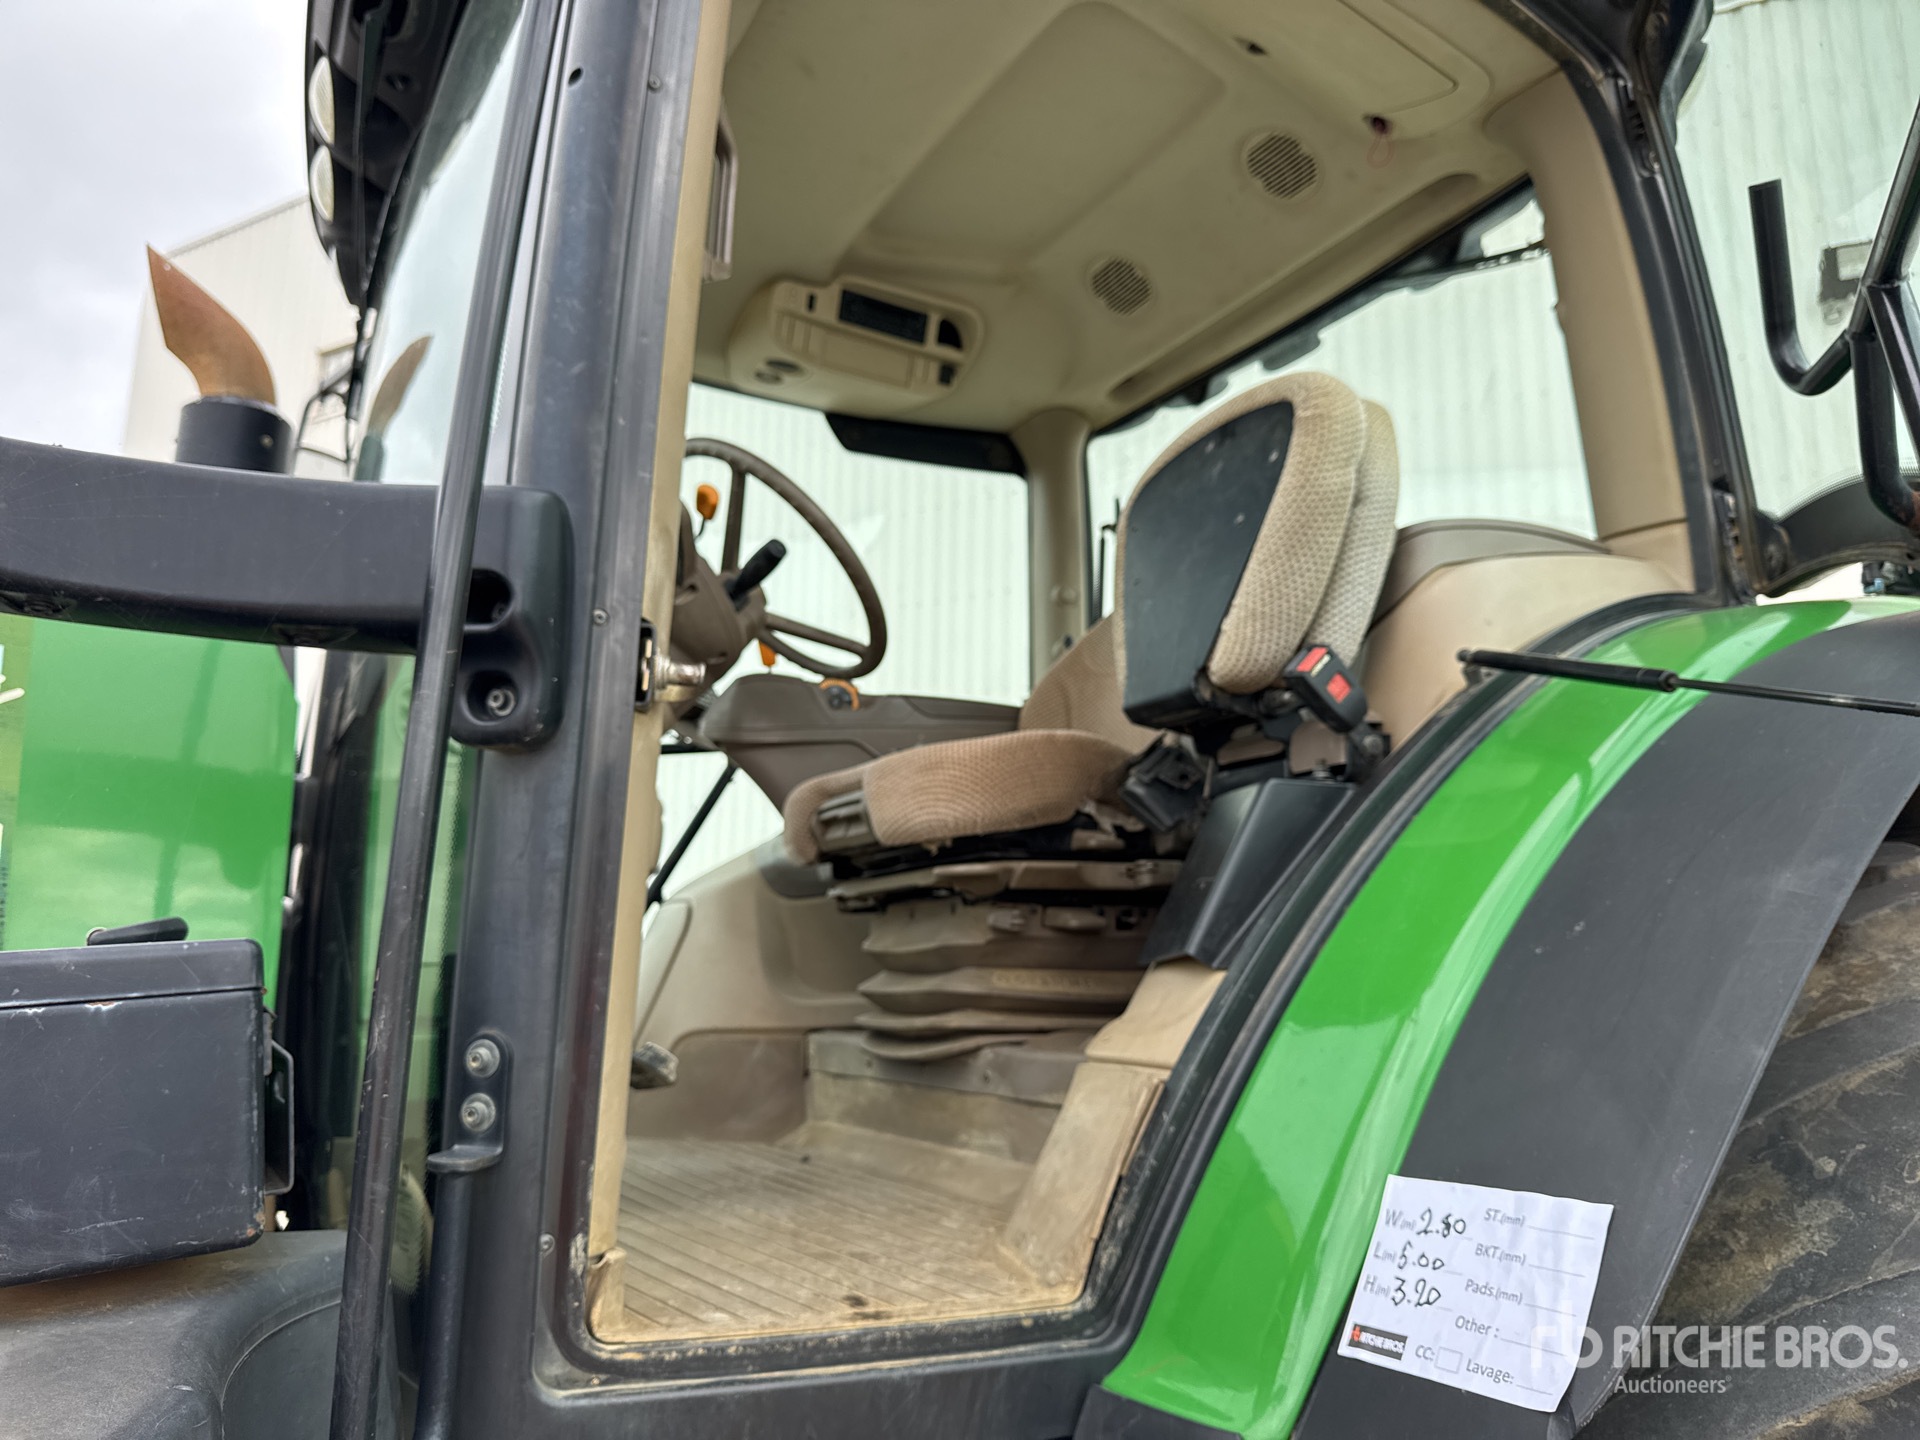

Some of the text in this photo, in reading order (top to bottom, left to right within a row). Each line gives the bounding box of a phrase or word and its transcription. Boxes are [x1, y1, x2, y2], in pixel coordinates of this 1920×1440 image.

[1397, 1240, 1445, 1271] 5.00
[1455, 1315, 1492, 1336] Other
[1465, 1358, 1515, 1385] Lavage:
